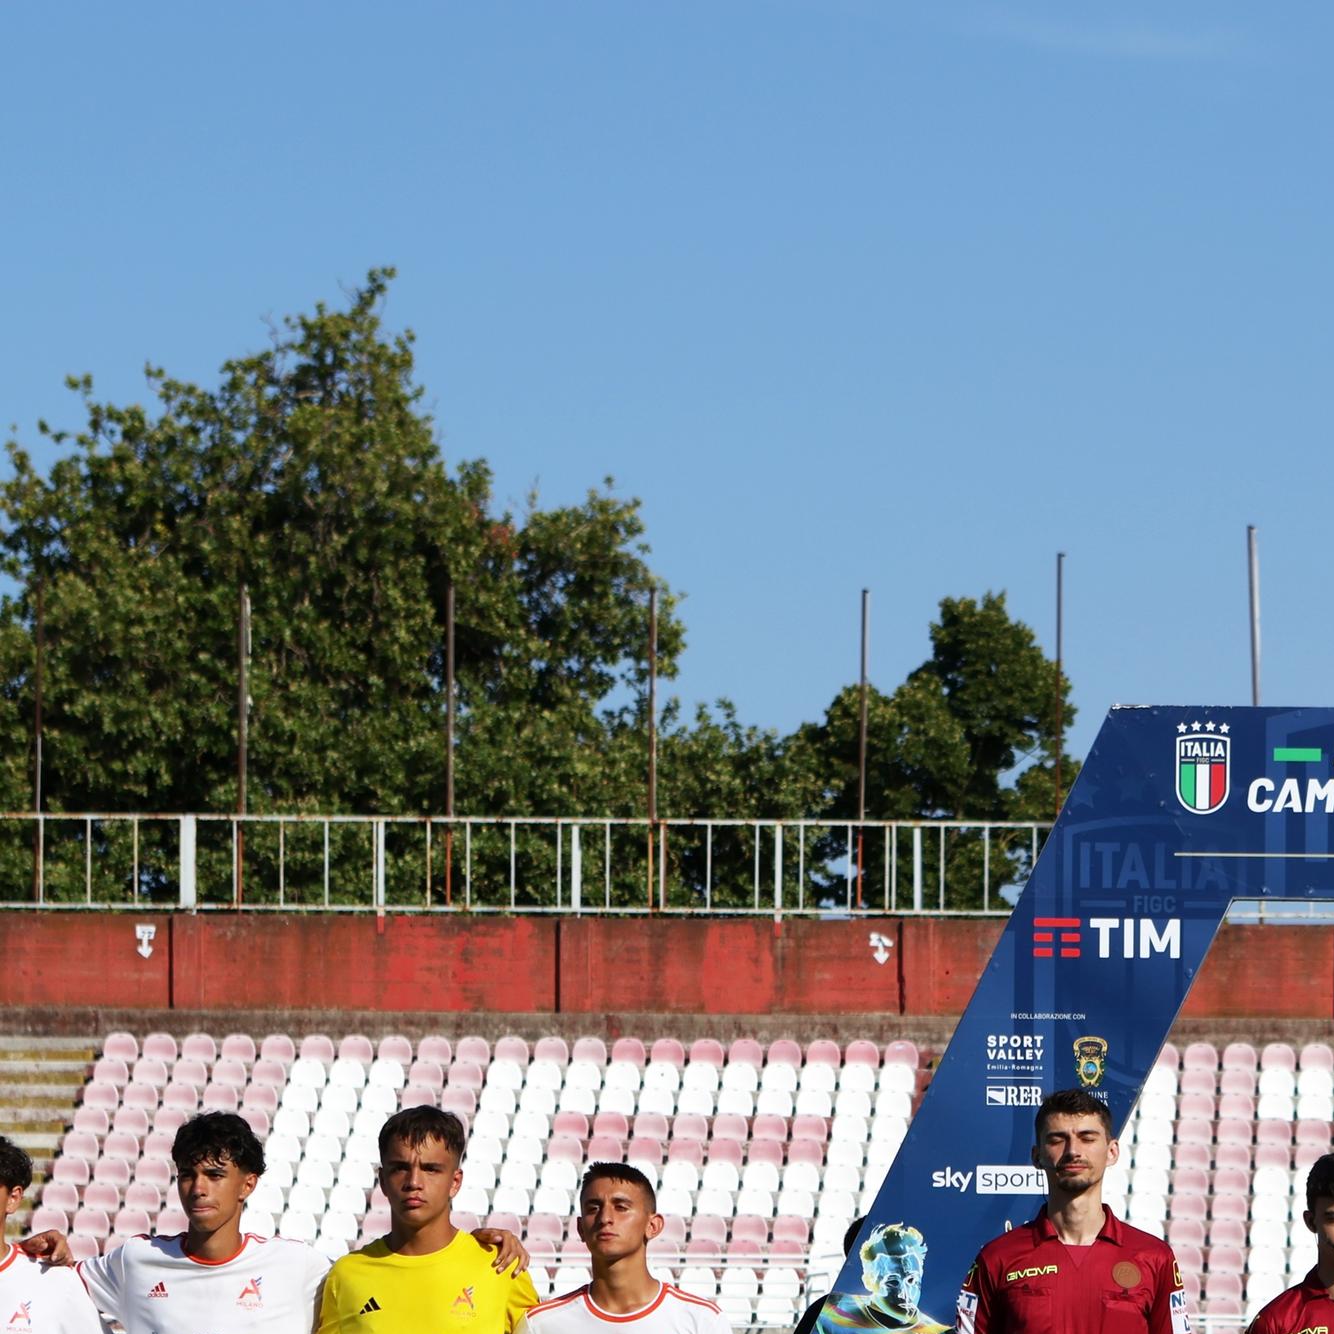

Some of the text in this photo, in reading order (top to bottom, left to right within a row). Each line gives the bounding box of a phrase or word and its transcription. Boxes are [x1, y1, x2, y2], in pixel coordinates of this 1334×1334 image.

[1181, 742, 1225, 758] ITALIA
[1090, 918, 1181, 959] TIM
[987, 1035, 1044, 1048] SPORT
[987, 1049, 1044, 1061] VALLEY
[932, 1166, 1045, 1192] sky sport
[1006, 1265, 1058, 1282] GIVOVA
